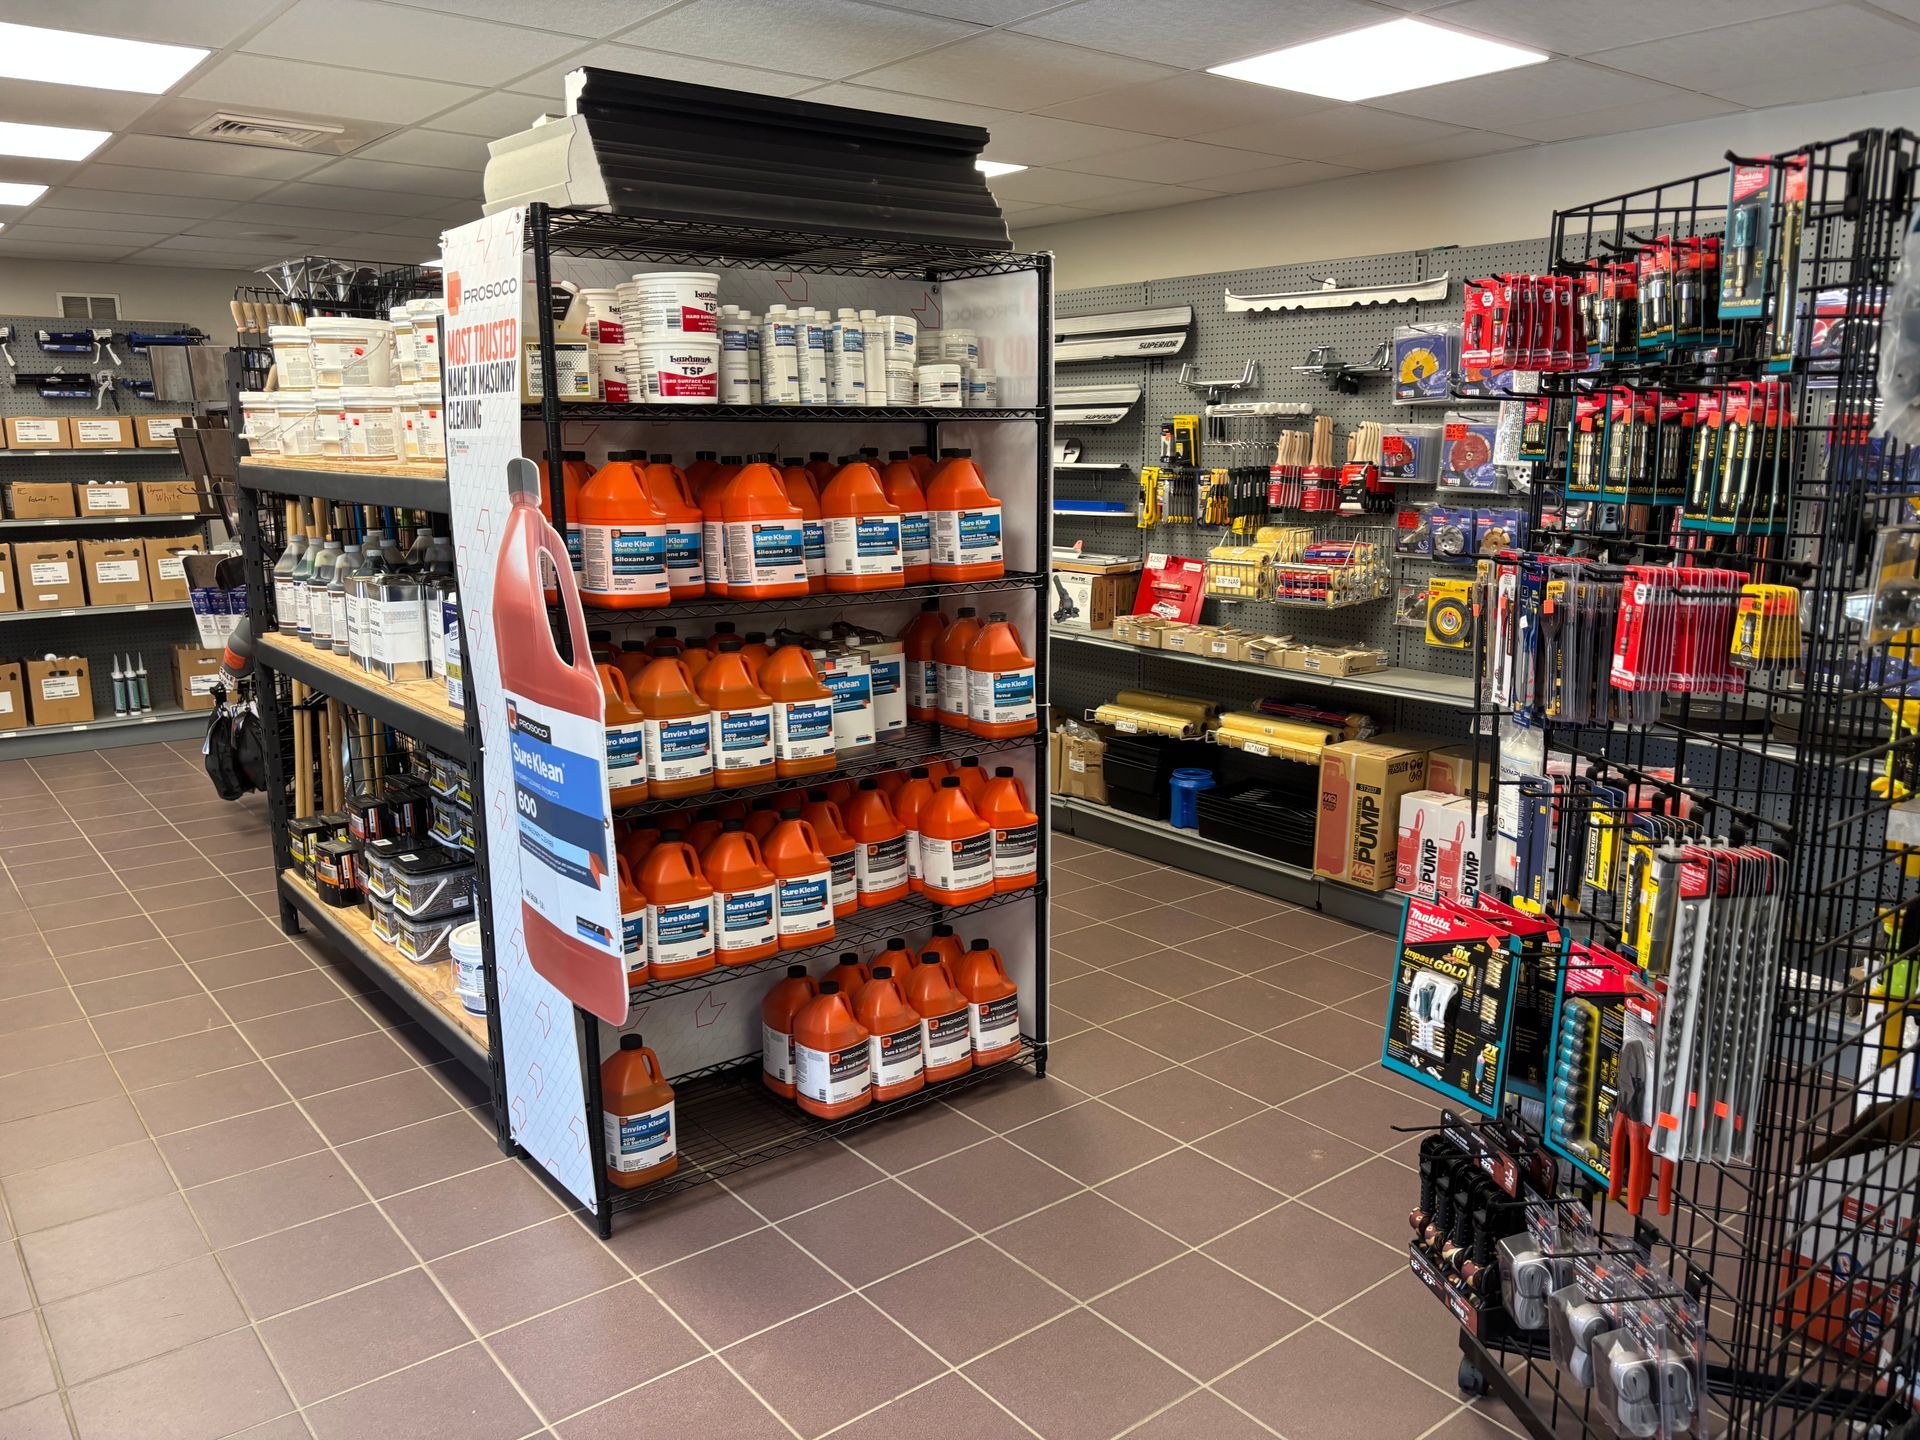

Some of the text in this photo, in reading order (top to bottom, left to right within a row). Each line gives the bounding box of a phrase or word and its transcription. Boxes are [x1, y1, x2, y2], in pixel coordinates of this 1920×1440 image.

[463, 277, 518, 305] PROSOCO
[448, 318, 517, 366] MOST TRUSTED
[1138, 340, 1179, 350] SUPERIOR
[670, 355, 712, 364] Lundmark
[682, 367, 704, 375] TSP
[448, 360, 516, 397] NAME IN MASONRY
[448, 399, 482, 430] CLEANING
[1083, 413, 1122, 421] SUPERIOR
[614, 540, 655, 548] Sure Klean
[755, 533, 793, 542] Sure Klean
[838, 680, 860, 689] Klean
[789, 710, 829, 720] Enviro Klean
[518, 718, 549, 738] PROSOCO
[723, 718, 767, 729] Enviro Klean
[662, 726, 706, 738] Enviro Klean
[619, 735, 638, 744] Klean
[513, 741, 564, 785] Sure Klean
[517, 790, 537, 818] 600
[1358, 795, 1380, 865] PUMP
[1422, 838, 1438, 884] PUMP
[1587, 832, 1598, 880] BLACK OXIDE
[1352, 862, 1375, 879] MQ
[1464, 851, 1480, 896] PUMP
[1681, 867, 1706, 880] Makita
[781, 885, 819, 896] Sure Klean
[1417, 882, 1435, 893] MQ
[744, 899, 764, 908] Klean
[659, 911, 700, 923] Sure Klean
[1410, 908, 1451, 931] Makita
[623, 924, 636, 933] ean
[1452, 947, 1471, 961] 10X
[1404, 947, 1467, 979] Impact GOLD
[1483, 1043, 1499, 1056] 2X
[621, 1117, 667, 1134] Enviro Klean
[631, 1137, 650, 1145] Surface
